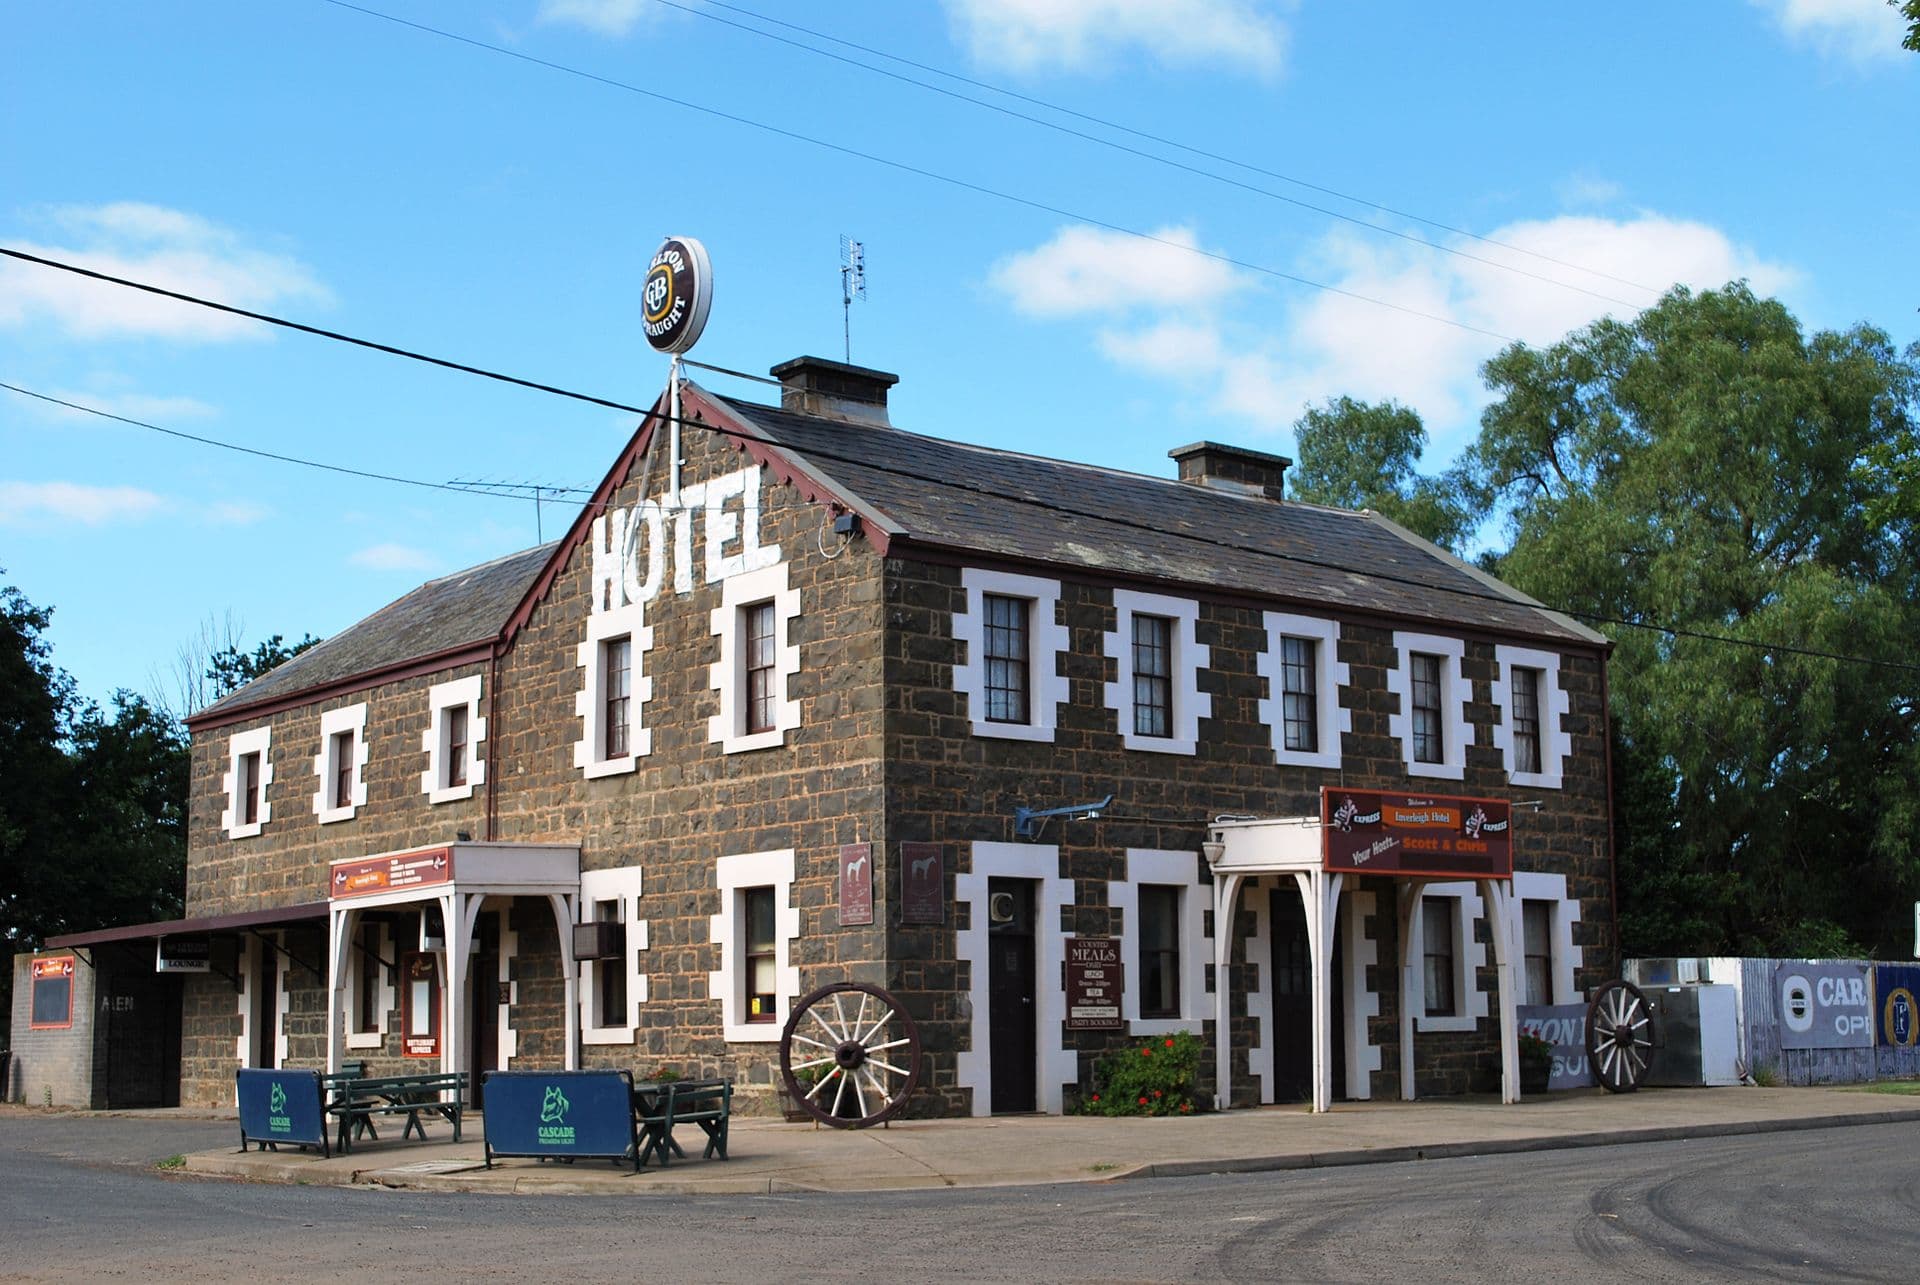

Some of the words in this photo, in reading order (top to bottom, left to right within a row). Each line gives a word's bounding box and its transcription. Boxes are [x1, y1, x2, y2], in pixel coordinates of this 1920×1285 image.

[591, 465, 782, 615] HOTEL
[1353, 811, 1381, 824] EXPRESS
[1395, 811, 1429, 824] Inverleigh
[1431, 812, 1450, 823] Hotel
[1483, 820, 1508, 832] EXPRESS
[1403, 836, 1439, 850] Scott
[1442, 839, 1451, 850] &
[1455, 839, 1488, 853] Chris
[1352, 848, 1371, 866] Your
[1072, 949, 1117, 961] MEALS
[168, 960, 204, 969] LOUNGE
[1085, 970, 1104, 978] LUNCH
[538, 1126, 576, 1138] CASCADE
